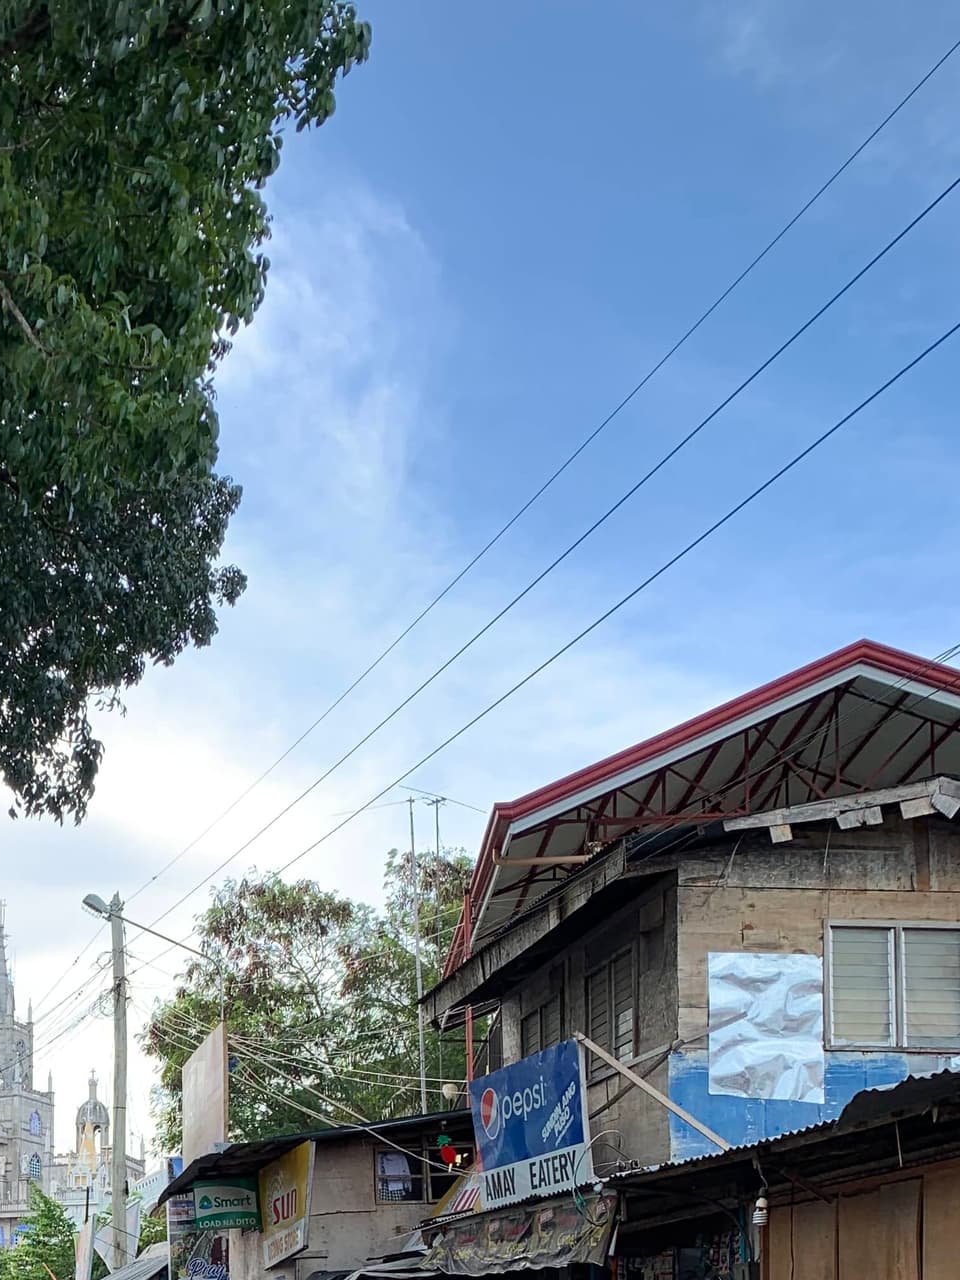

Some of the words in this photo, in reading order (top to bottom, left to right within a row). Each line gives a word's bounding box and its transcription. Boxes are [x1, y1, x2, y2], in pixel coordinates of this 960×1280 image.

[502, 1076, 545, 1129] pepsi
[562, 1080, 576, 1110] ANG
[528, 1150, 577, 1191] EATERY
[214, 1194, 252, 1208] Smart
[200, 1219, 222, 1228] LOAD
[236, 1217, 257, 1226] DITO
